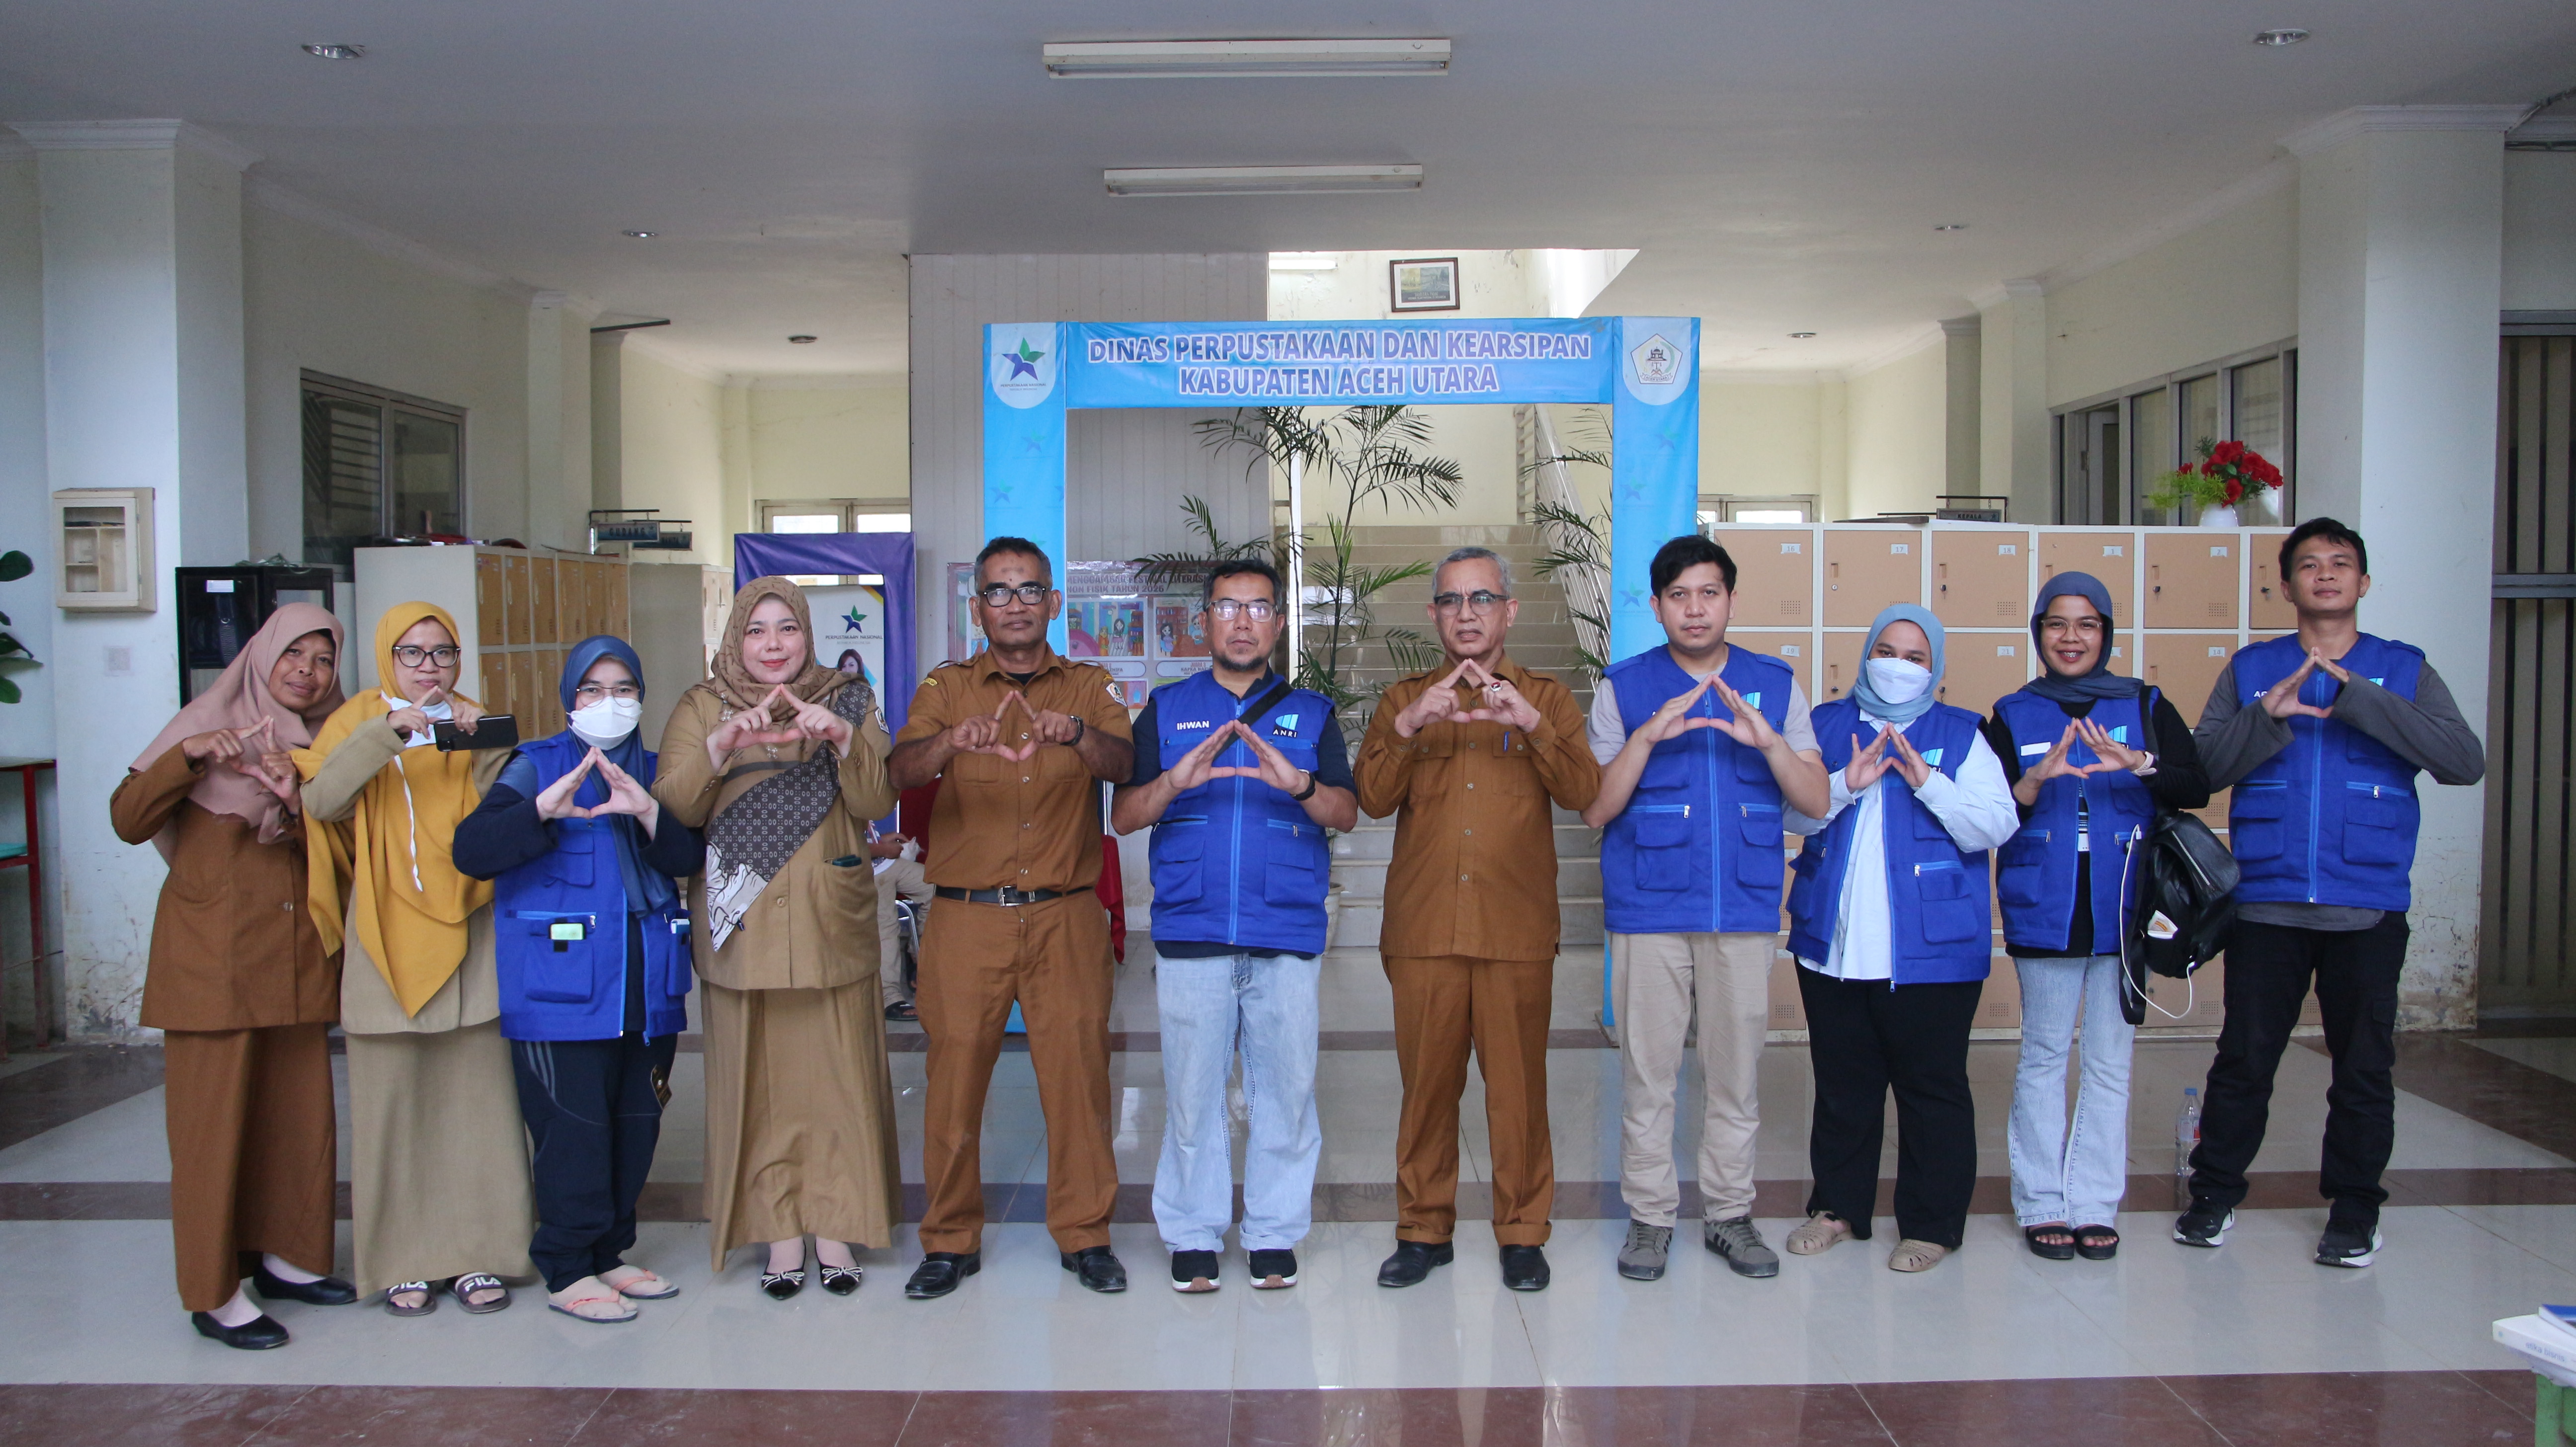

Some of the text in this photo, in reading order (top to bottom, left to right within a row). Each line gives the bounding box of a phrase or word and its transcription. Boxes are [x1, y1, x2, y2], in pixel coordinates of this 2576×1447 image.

[1089, 330, 1592, 363] DINAS PERPUSTAKAAN DAN KEARSIPAN
[1179, 364, 1500, 397] KABUPATEN ACEH UTARA
[609, 527, 645, 537] GUDANG
[1177, 721, 1209, 730] IHWAN
[1273, 729, 1298, 738] ANRI
[464, 1277, 501, 1291] FILA
[2526, 1342, 2565, 1362] etika bisnis
